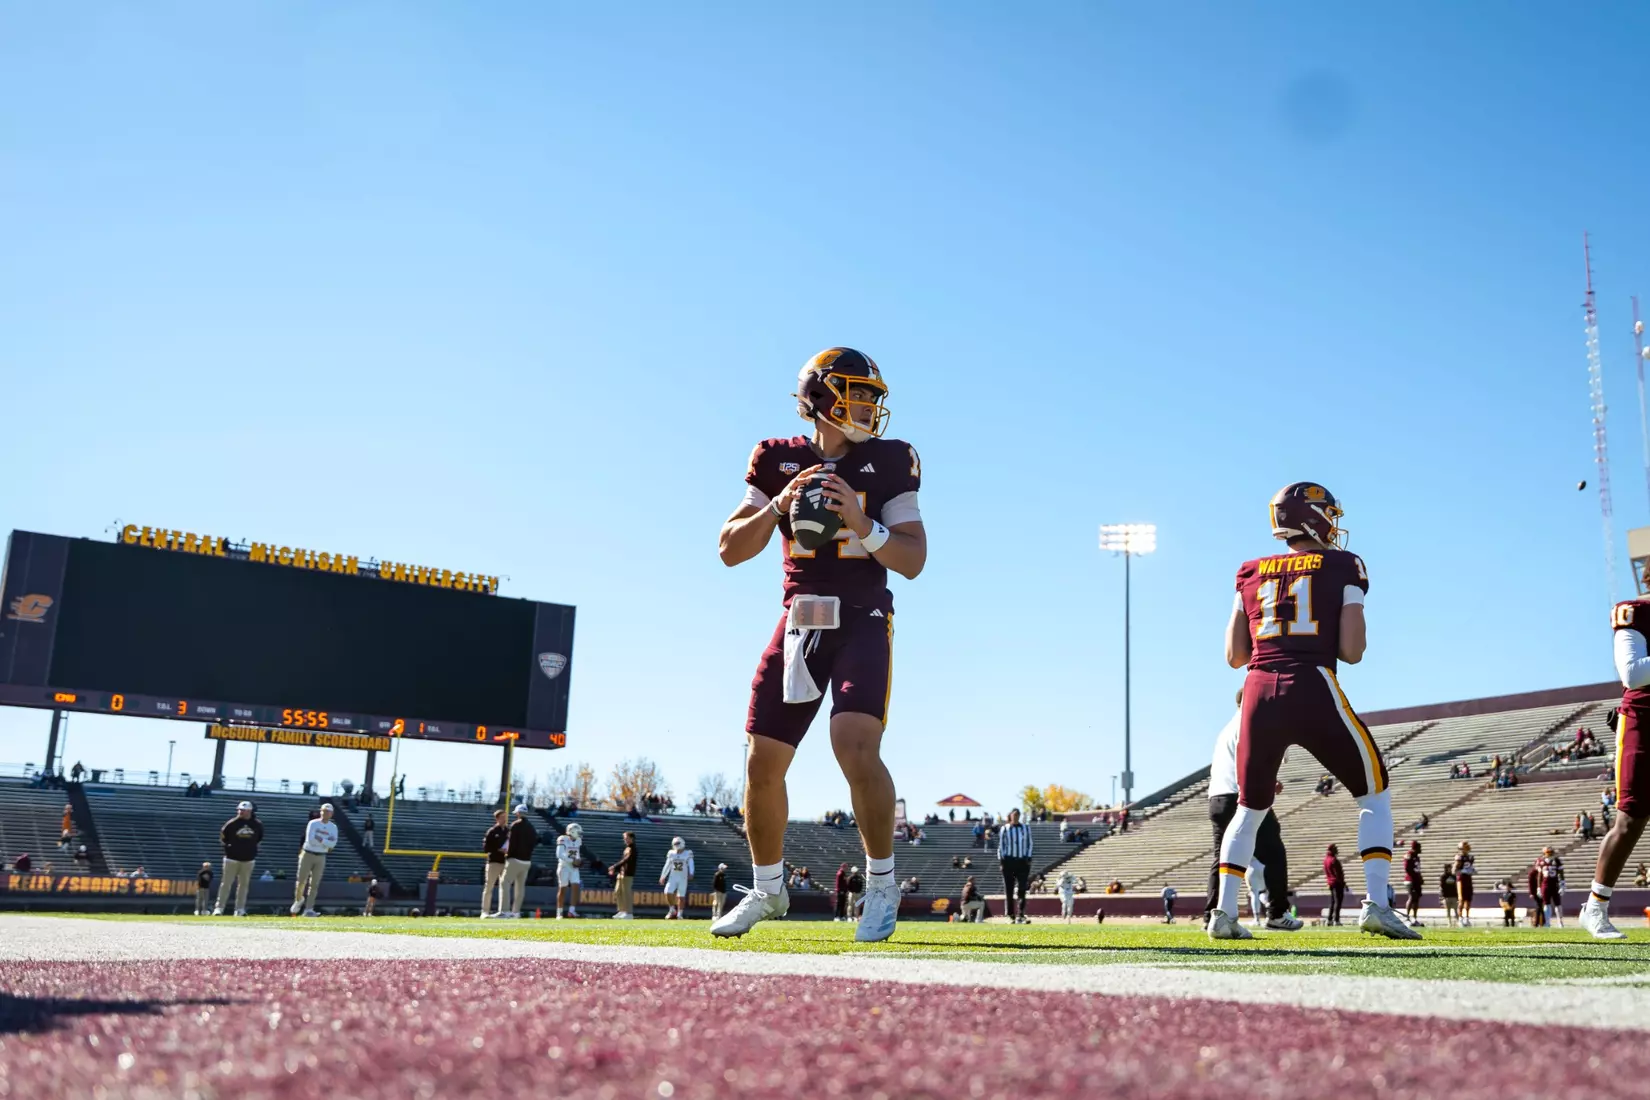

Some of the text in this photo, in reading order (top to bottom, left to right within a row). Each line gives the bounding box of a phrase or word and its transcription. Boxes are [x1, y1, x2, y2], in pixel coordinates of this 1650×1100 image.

[123, 524, 499, 593] CENTRAL MICHIGAN UNIVERSITY
[1258, 554, 1324, 575] WATTERS
[1256, 575, 1319, 639] 11
[111, 694, 124, 711] 0
[178, 701, 187, 715] 3
[197, 705, 216, 714] DOWN
[282, 708, 329, 728] 55:55
[210, 725, 391, 750] McGUIRK FAMILY SCOREBOARD
[476, 725, 487, 741] 0
